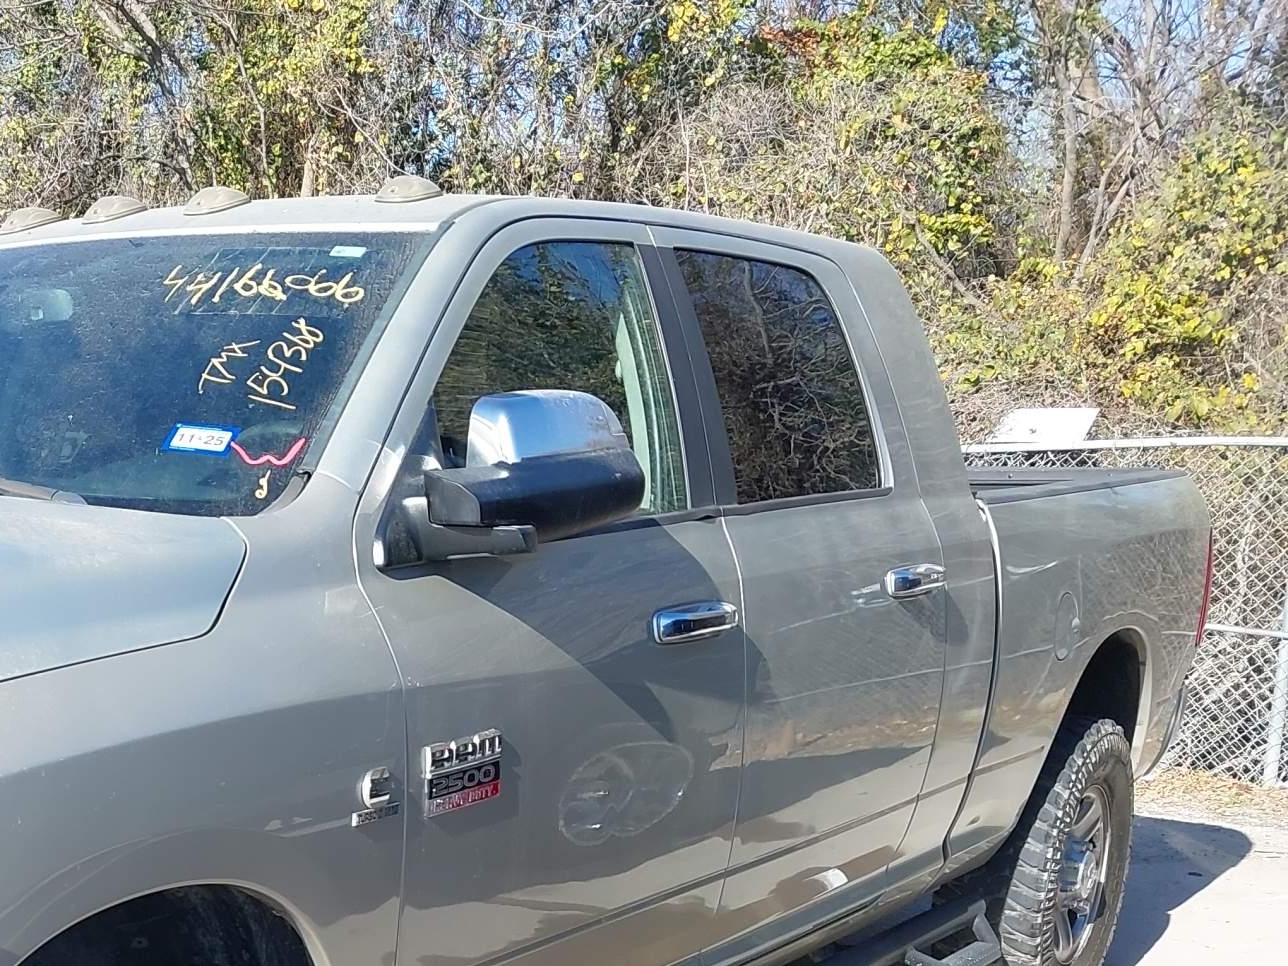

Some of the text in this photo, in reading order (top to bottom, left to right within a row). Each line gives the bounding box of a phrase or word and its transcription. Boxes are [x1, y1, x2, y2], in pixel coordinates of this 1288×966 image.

[162, 263, 365, 304] 44166066
[423, 728, 502, 773] RAM
[431, 765, 496, 798] 2500
